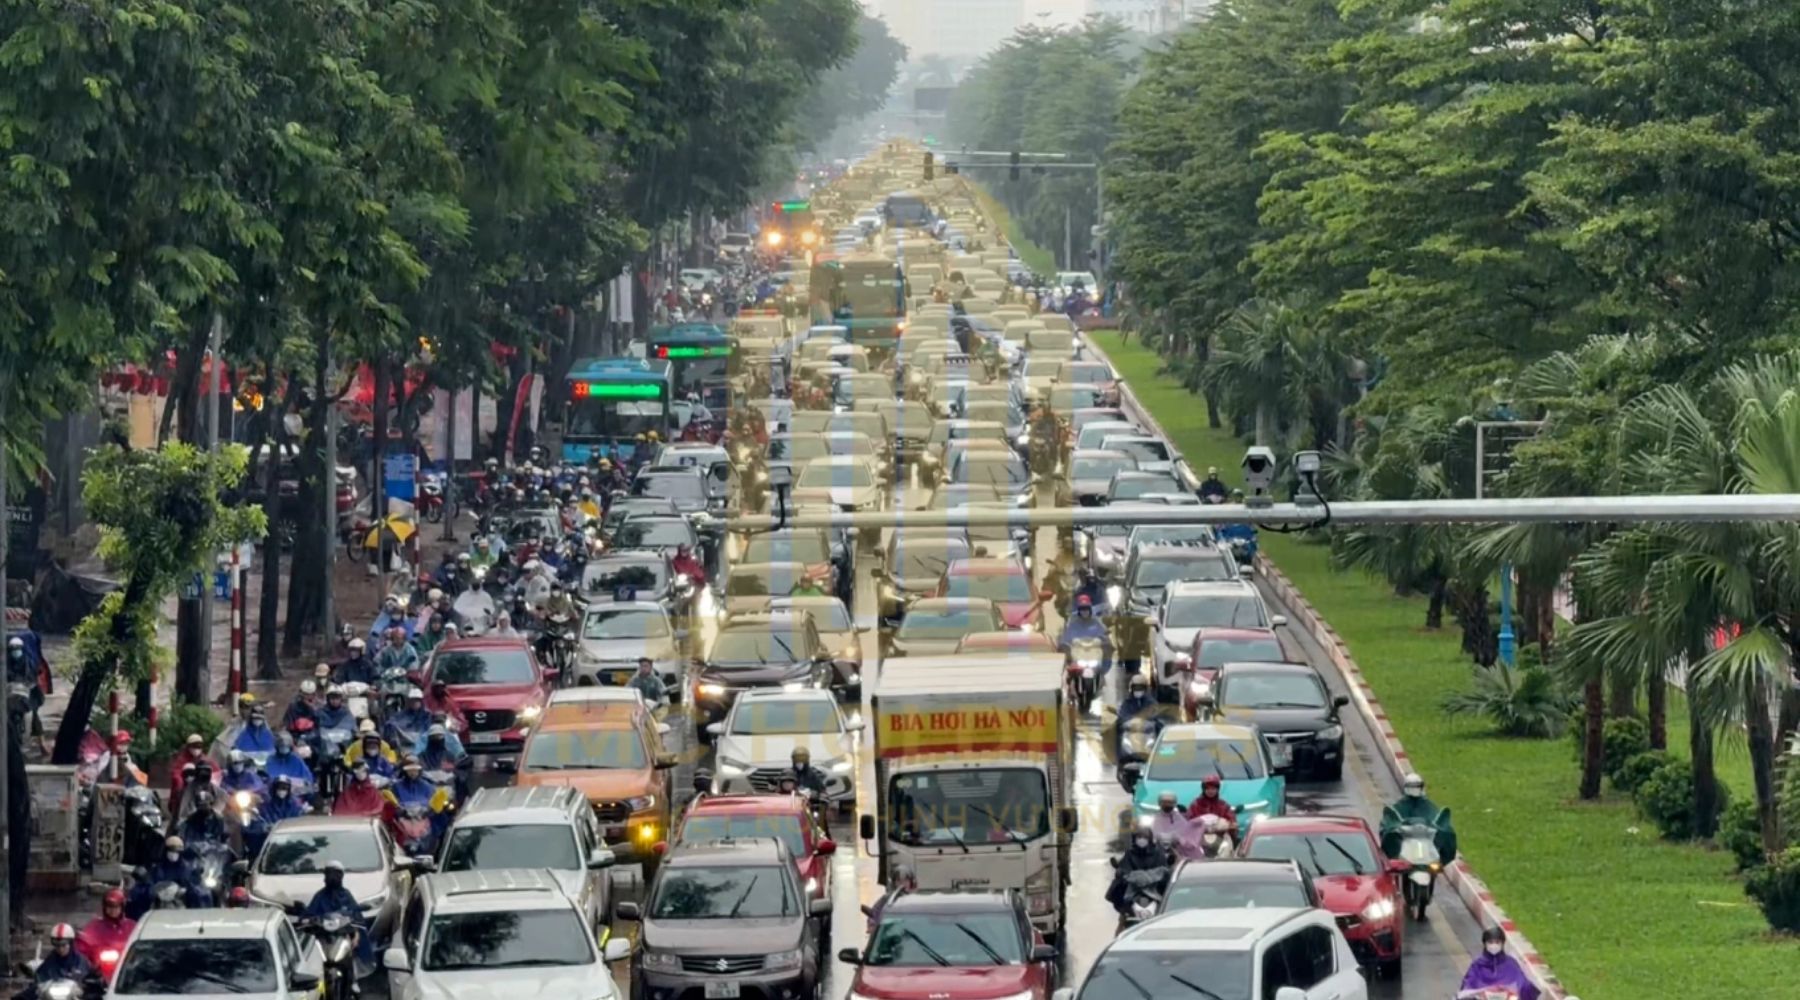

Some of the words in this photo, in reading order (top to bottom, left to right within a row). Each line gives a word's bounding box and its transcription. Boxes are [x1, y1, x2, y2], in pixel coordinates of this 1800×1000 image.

[575, 383, 589, 395] 33
[890, 713, 925, 732] BIA
[974, 706, 1003, 729] HÀ
